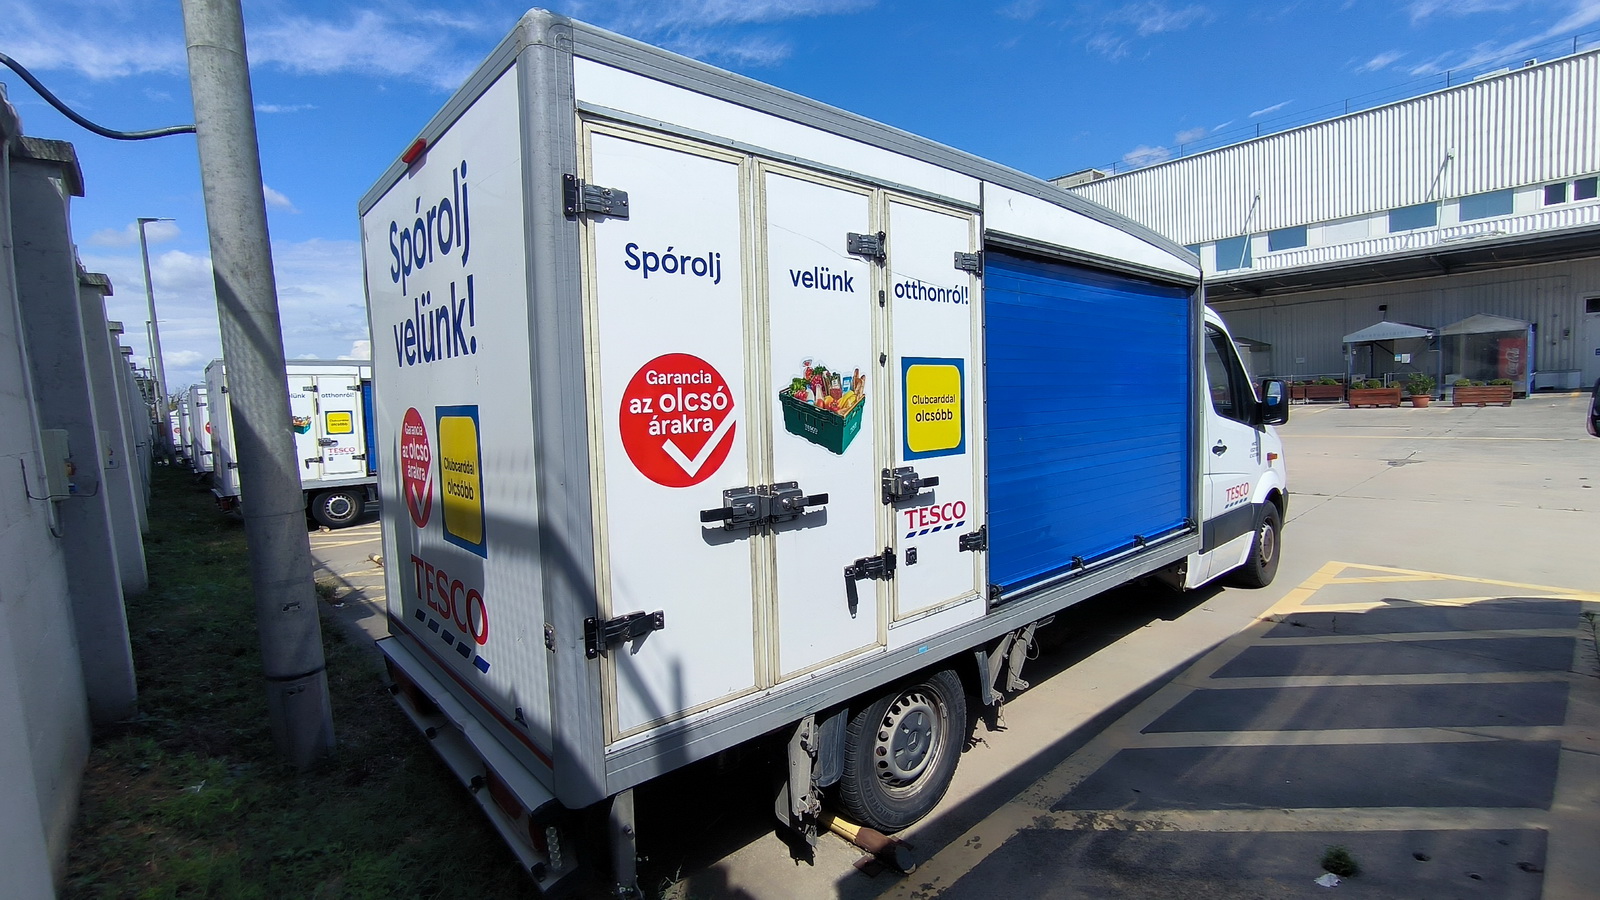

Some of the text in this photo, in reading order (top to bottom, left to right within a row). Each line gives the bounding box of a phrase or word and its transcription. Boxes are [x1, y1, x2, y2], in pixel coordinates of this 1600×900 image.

[390, 160, 470, 296] Spórolj
[624, 242, 721, 285] Spórolj
[789, 267, 855, 293] velünk
[894, 279, 969, 305] otthonról!
[394, 274, 477, 368] velünk!
[646, 370, 712, 385] Garancia
[629, 386, 728, 414] az olcsó
[911, 394, 956, 405] Clubcarddal
[648, 414, 714, 436] árakra
[915, 408, 953, 423] olcsóbb
[404, 422, 423, 436] Garancia
[402, 437, 429, 463] az olcsó
[407, 460, 426, 482] árakra
[443, 456, 475, 476] Clubcarddal
[447, 478, 474, 501] olcsóbb
[1226, 482, 1250, 502] TESCO
[904, 500, 967, 529] TESCO
[411, 554, 489, 646] TESCO
